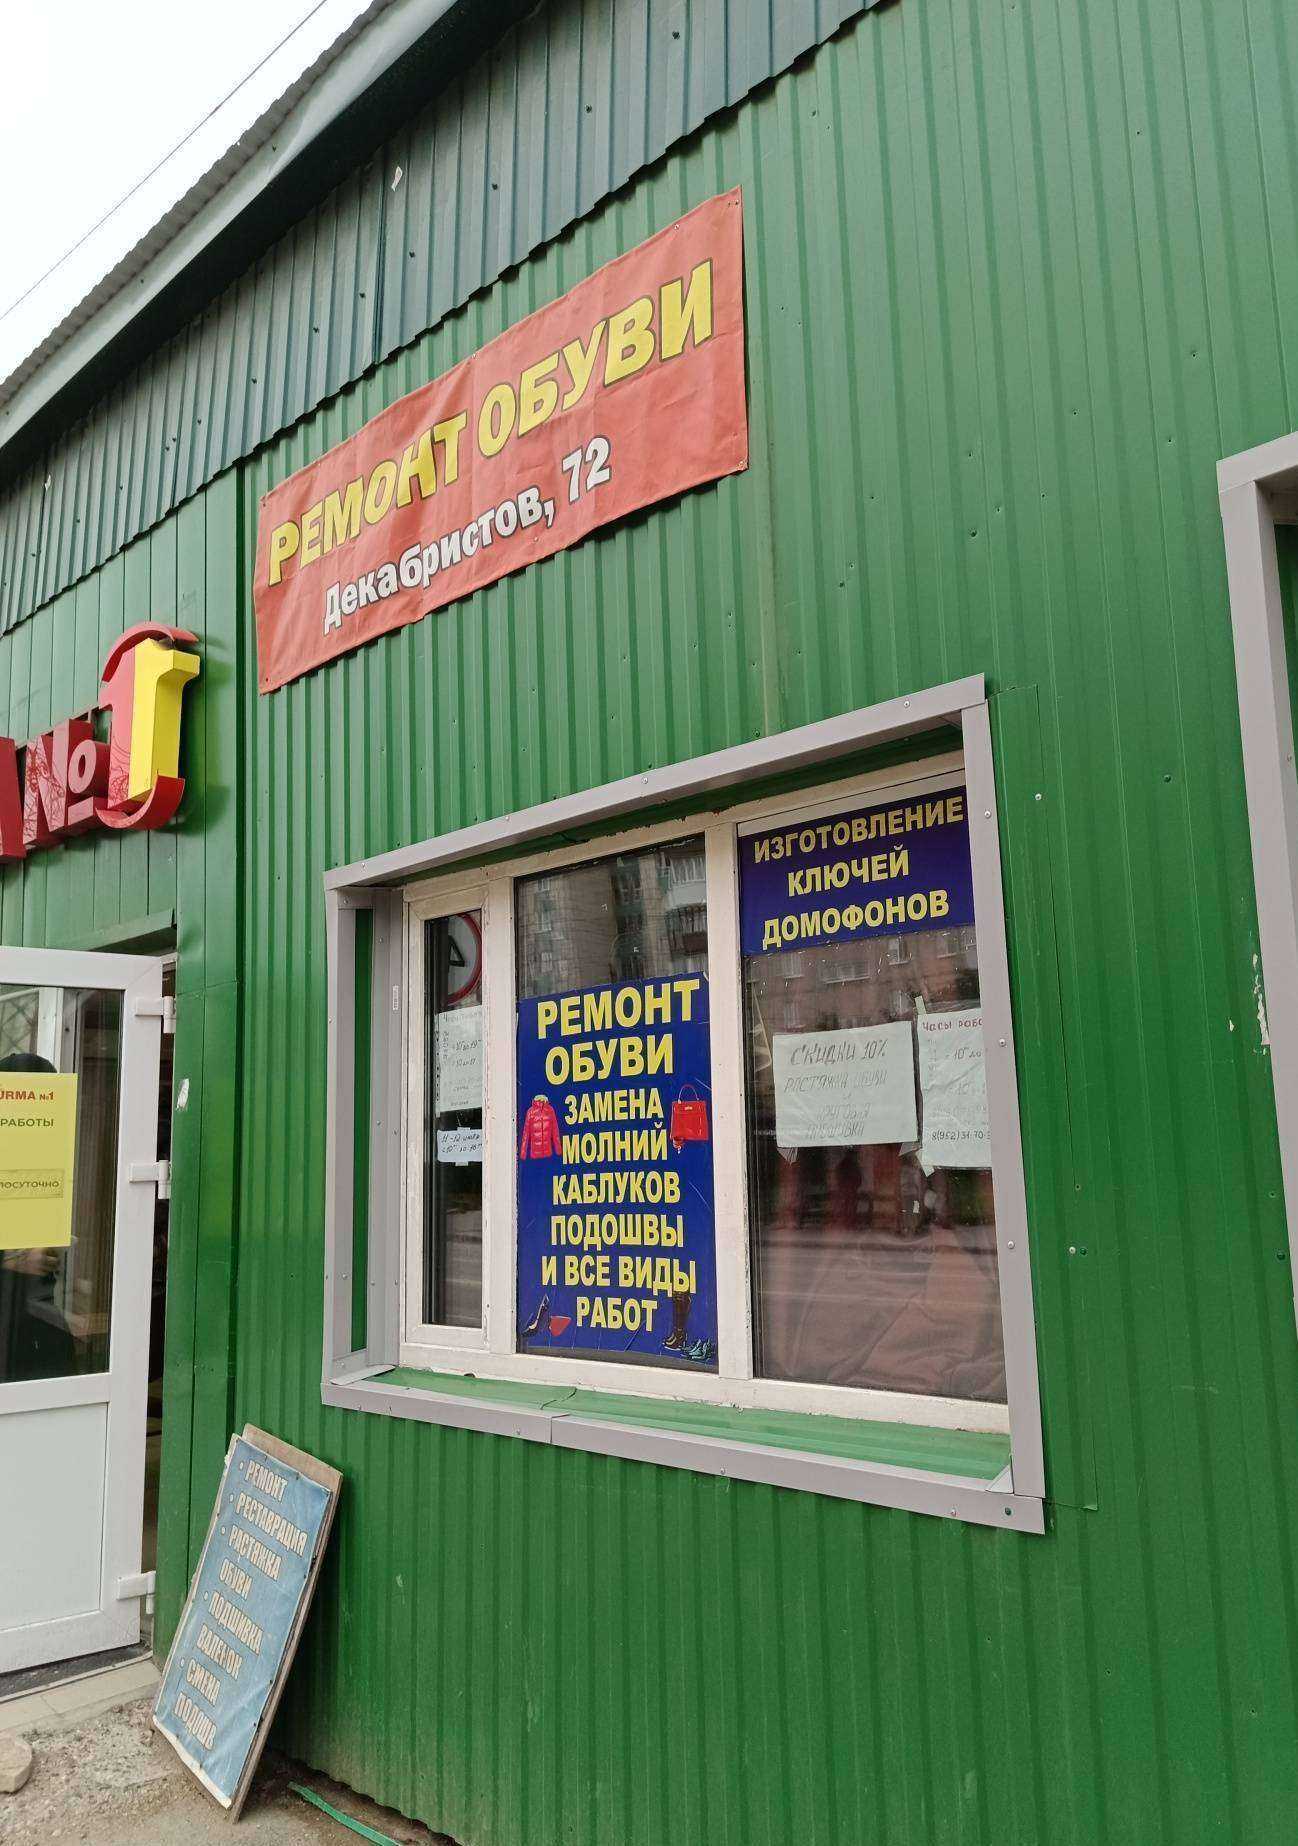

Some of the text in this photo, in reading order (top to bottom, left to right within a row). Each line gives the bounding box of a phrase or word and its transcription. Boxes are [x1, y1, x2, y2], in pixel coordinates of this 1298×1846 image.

[268, 257, 715, 588] РЕМОНТ ОБУВИ
[323, 435, 613, 636] Декабристов, 72
[753, 795, 965, 865] ИЗГОТОВЛЕНИЕ
[787, 844, 910, 898] КЛЮЧЕЙ
[762, 889, 950, 951] ДОМОФОНОВ
[537, 978, 700, 1040] РЕМОНТ
[545, 1033, 674, 1086] ОБУВИ
[791, 1038, 888, 1066] СКИДКИ 10%
[0, 1118, 55, 1128] РАБОТЫ
[564, 1087, 665, 1126] ЗАМЕНА
[562, 1121, 668, 1164] МОЛНИЙ
[552, 1170, 681, 1206] КАБЛУКОВ
[551, 1213, 685, 1251] ПОДОШВЫ
[541, 1254, 698, 1298] И ВСЕ ВИДЫ
[575, 1296, 659, 1333] РАБОТ
[245, 1459, 288, 1503] РЕМОНТ
[235, 1492, 309, 1558] РЕСТАВРАЦИЯ
[228, 1524, 283, 1582] РАСТЯЖКА
[220, 1558, 253, 1600] ОБУВИ
[208, 1590, 264, 1656] ПОДШИВКА
[186, 1658, 221, 1707] СМЕНА
[173, 1692, 218, 1751] ПОДОШВ
